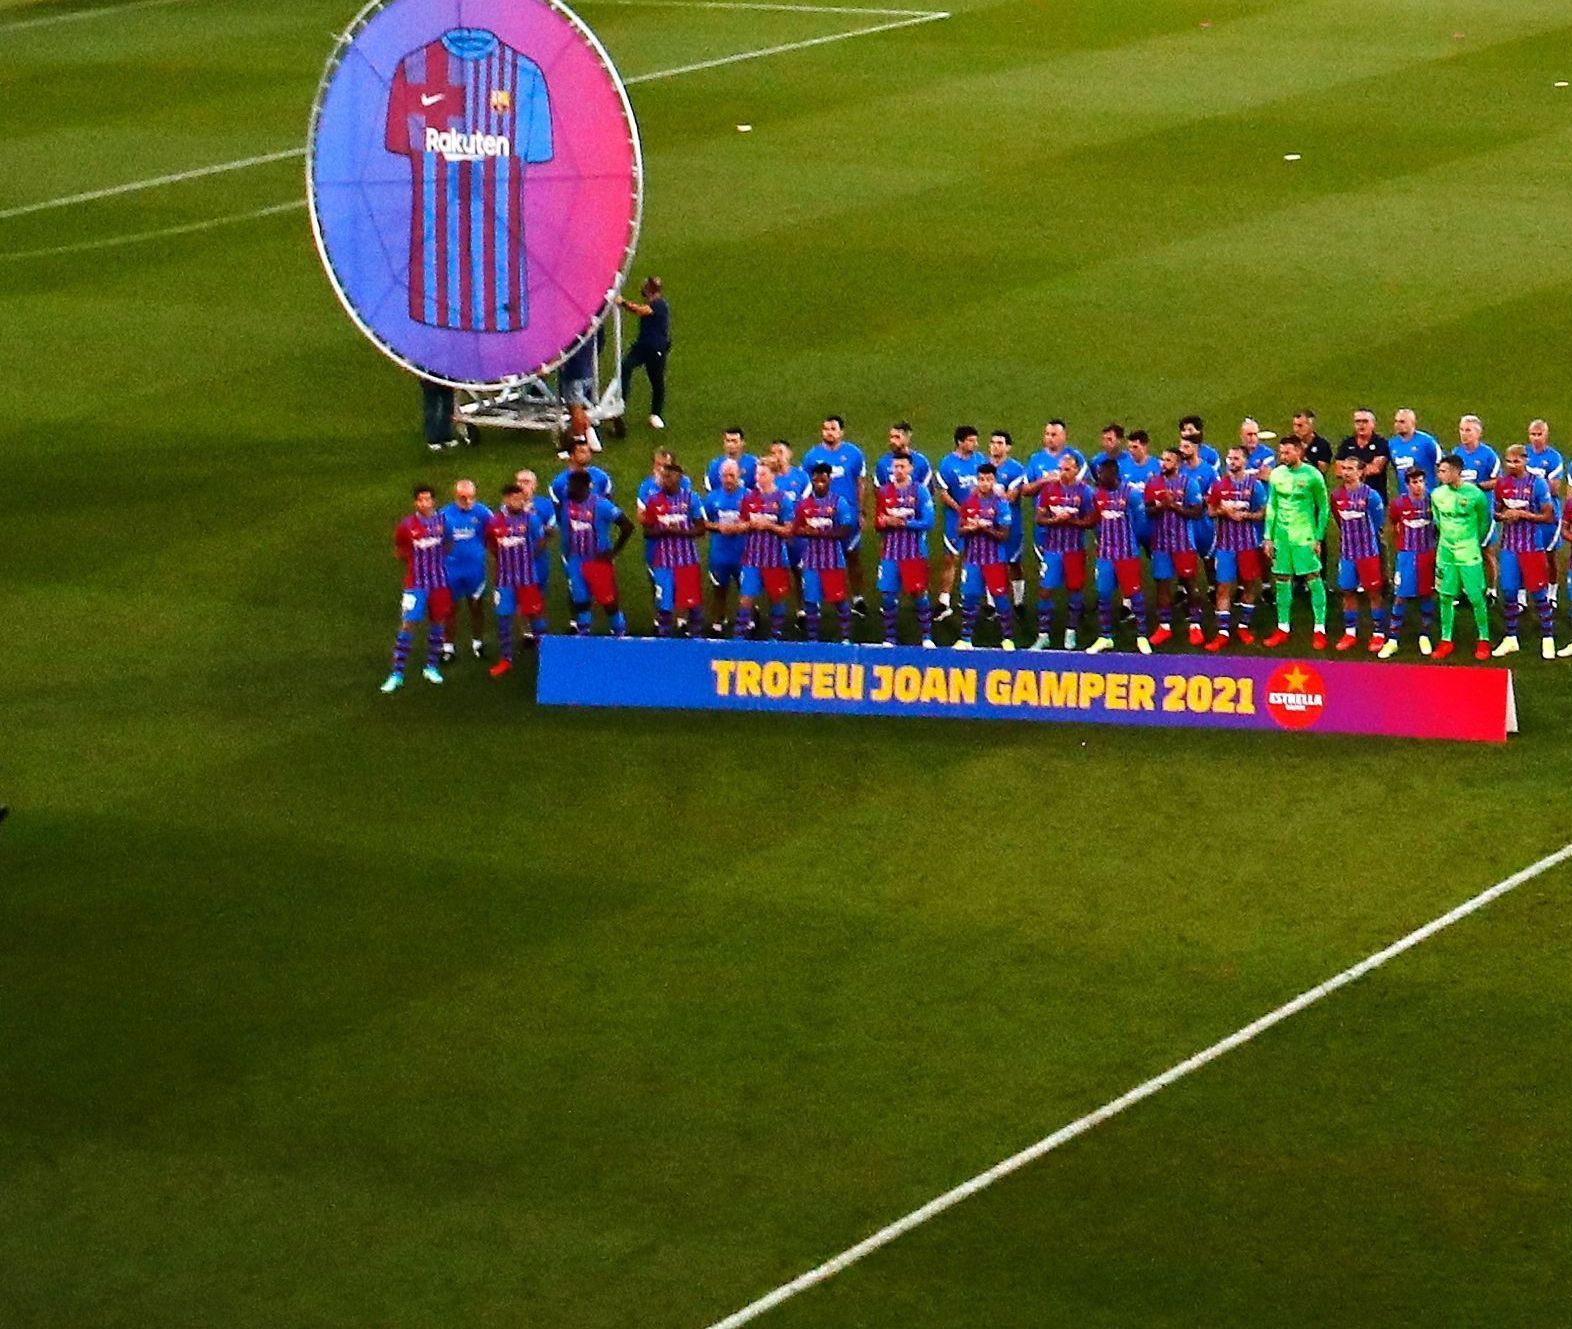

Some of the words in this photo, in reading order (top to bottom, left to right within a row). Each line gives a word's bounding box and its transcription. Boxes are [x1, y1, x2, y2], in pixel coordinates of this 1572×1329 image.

[426, 127, 510, 157] Rakuten
[712, 660, 864, 701] TROFEU
[870, 665, 977, 704] JOAN
[985, 669, 1156, 711] GAMPER
[1162, 675, 1256, 715] 2021
[1269, 692, 1323, 707] ESTRELLA
